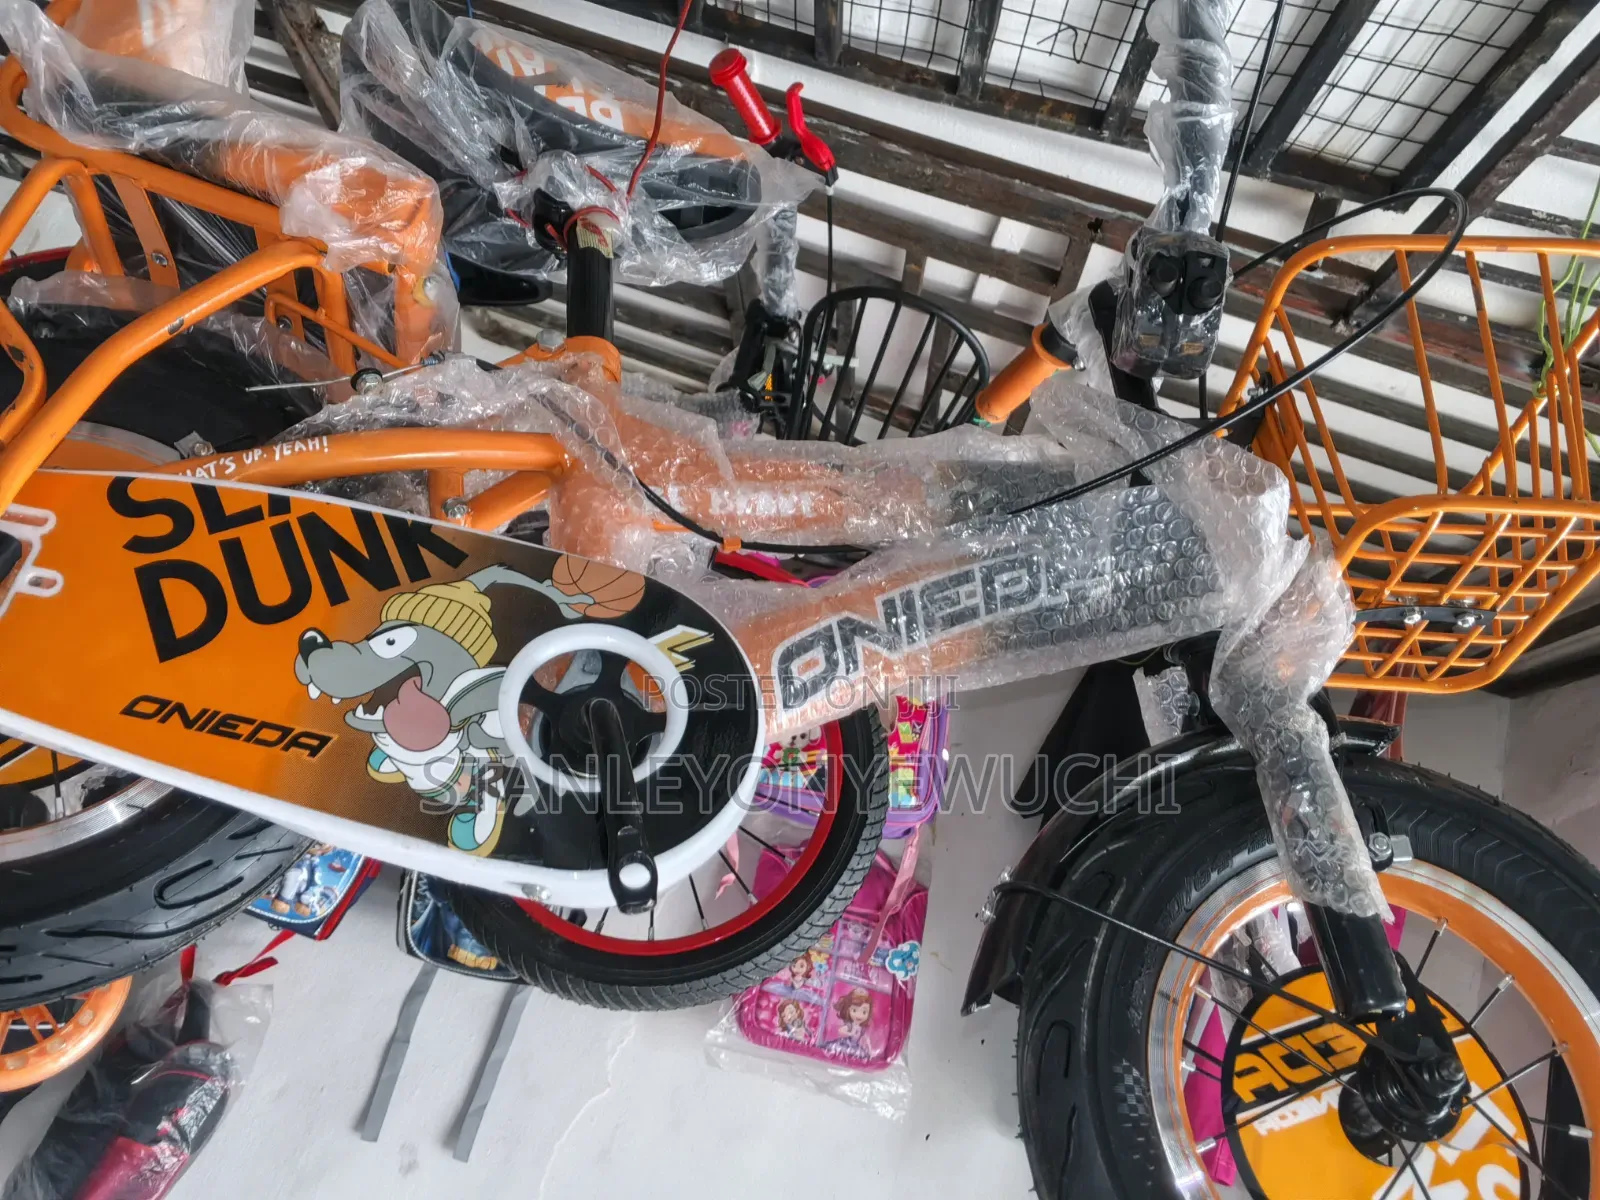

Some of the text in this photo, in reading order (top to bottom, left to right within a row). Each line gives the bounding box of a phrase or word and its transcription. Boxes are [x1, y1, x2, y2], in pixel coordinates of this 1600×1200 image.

[273, 435, 329, 461] YEAH!
[133, 511, 471, 664] DUNK
[118, 694, 338, 759] ONIEDA
